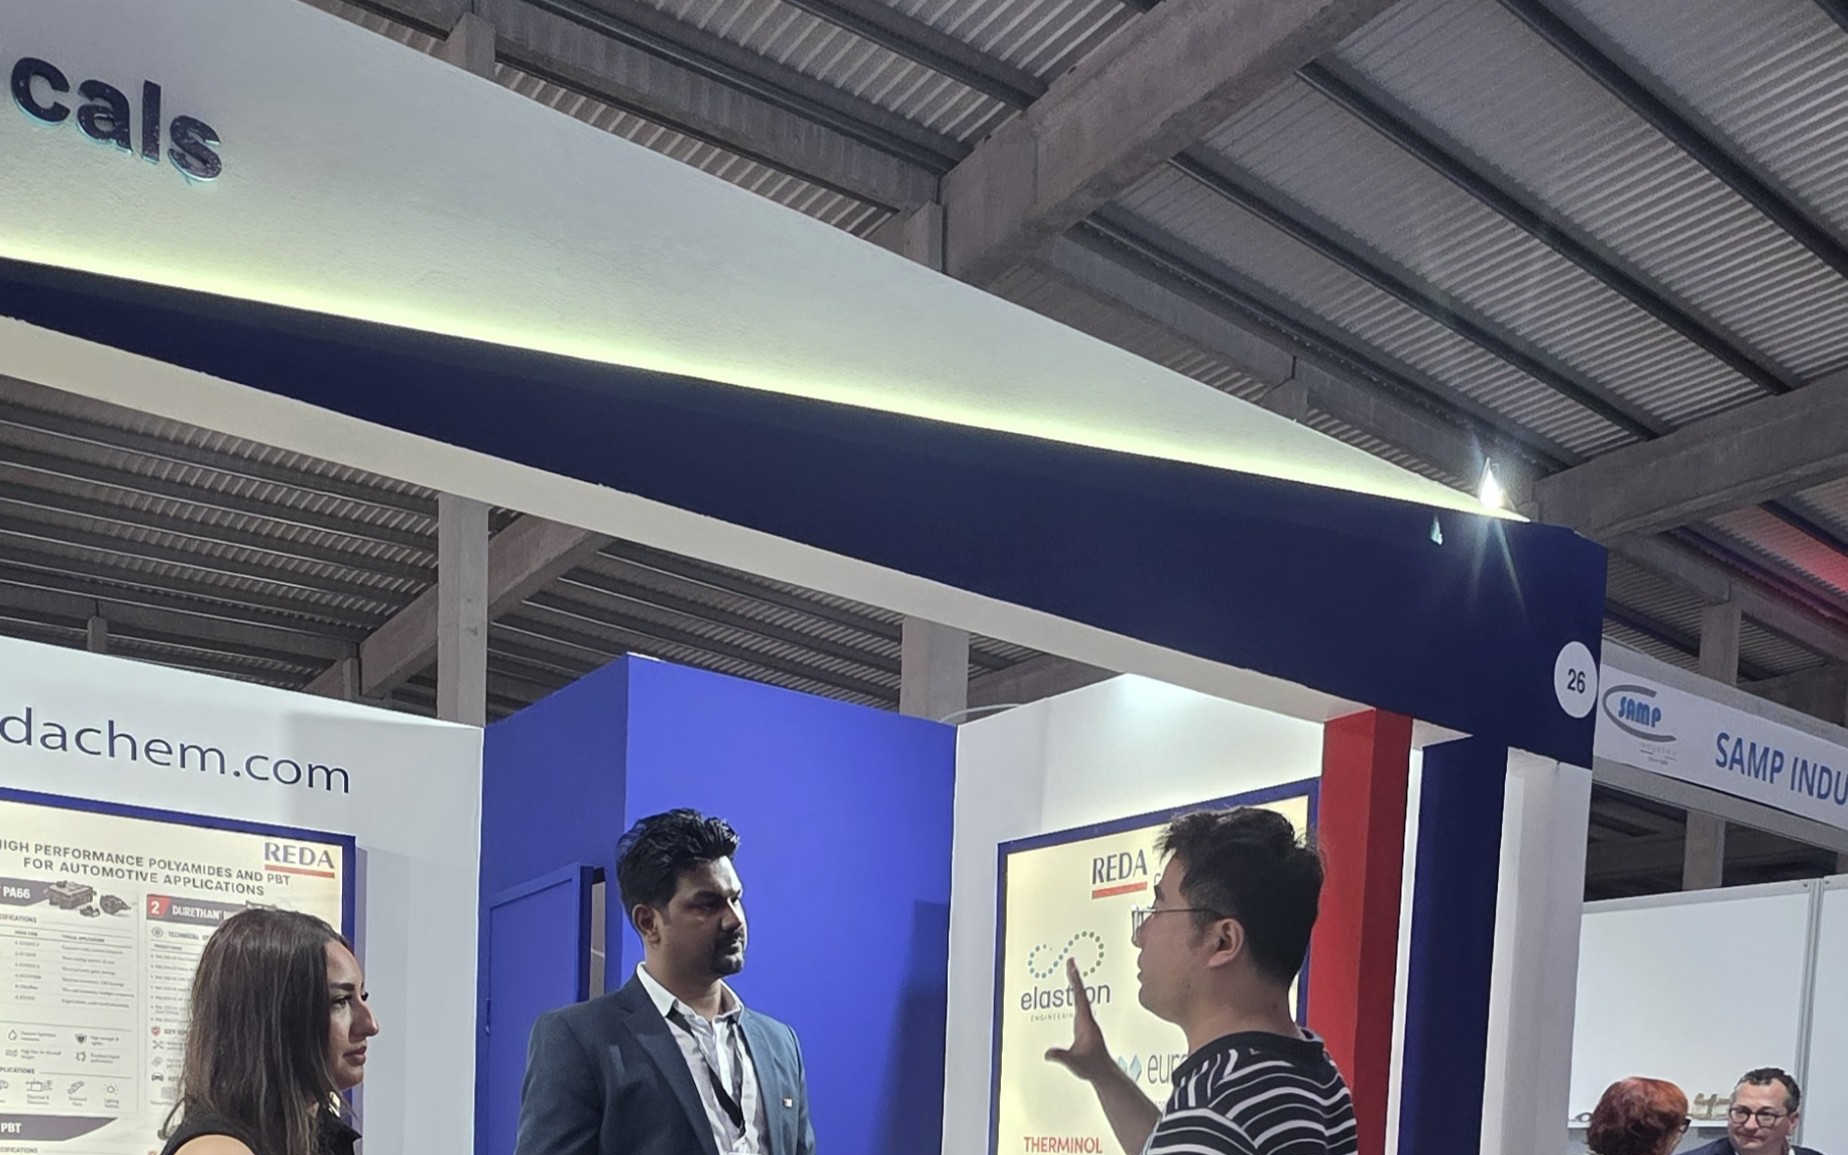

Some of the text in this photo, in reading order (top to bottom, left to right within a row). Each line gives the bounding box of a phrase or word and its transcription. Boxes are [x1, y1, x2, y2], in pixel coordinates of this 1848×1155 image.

[11, 57, 223, 183] cals
[1567, 668, 1586, 694] 26
[1618, 696, 1662, 728] SAMP
[0, 706, 350, 794] dachem.com
[1715, 732, 1848, 806] SAMP INDU
[34, 843, 144, 867] PERFORMANCE
[149, 858, 232, 878] POLYAMIDES
[236, 869, 263, 882] AND
[267, 872, 291, 886] PBT
[264, 842, 335, 869] REDA
[1092, 849, 1148, 885] REDA
[23, 857, 265, 896] FOR AUTOMOTIVE APPLICATIONS
[150, 902, 160, 915] 2
[1020, 984, 1111, 1011] elaston
[0, 1122, 22, 1133] PBT
[1023, 1136, 1103, 1154] THERMINOL
